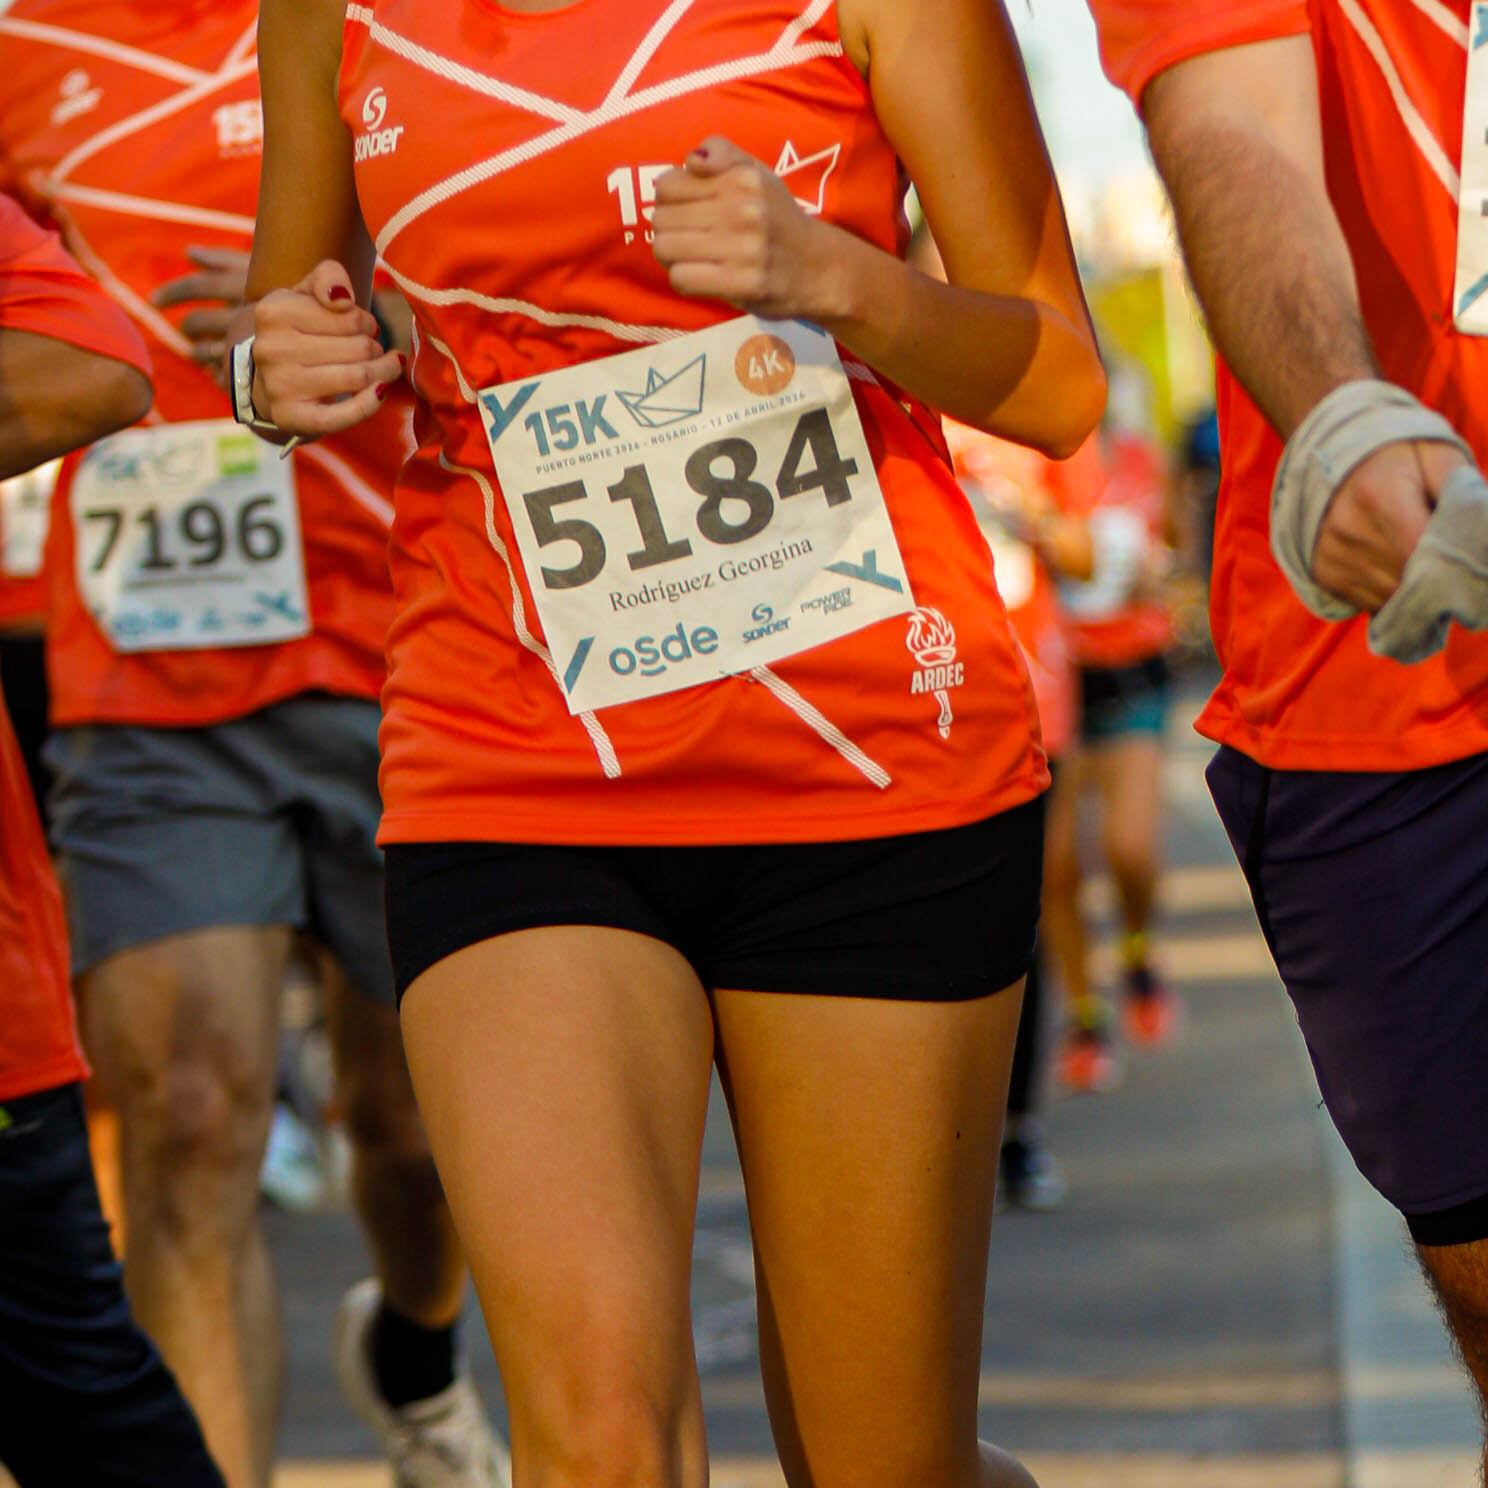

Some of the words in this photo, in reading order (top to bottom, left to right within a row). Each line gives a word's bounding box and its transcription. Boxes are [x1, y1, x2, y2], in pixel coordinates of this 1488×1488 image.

[748, 350, 785, 380] 4K
[524, 395, 620, 457] 15K
[536, 457, 576, 475] PUERTO
[578, 447, 612, 464] NORTE
[650, 426, 698, 446] ROSARIO
[522, 407, 858, 590] 5184
[84, 495, 284, 572] 7196
[718, 538, 814, 582] Georgina
[608, 622, 719, 676] osde
[911, 661, 964, 694] ARDEC
